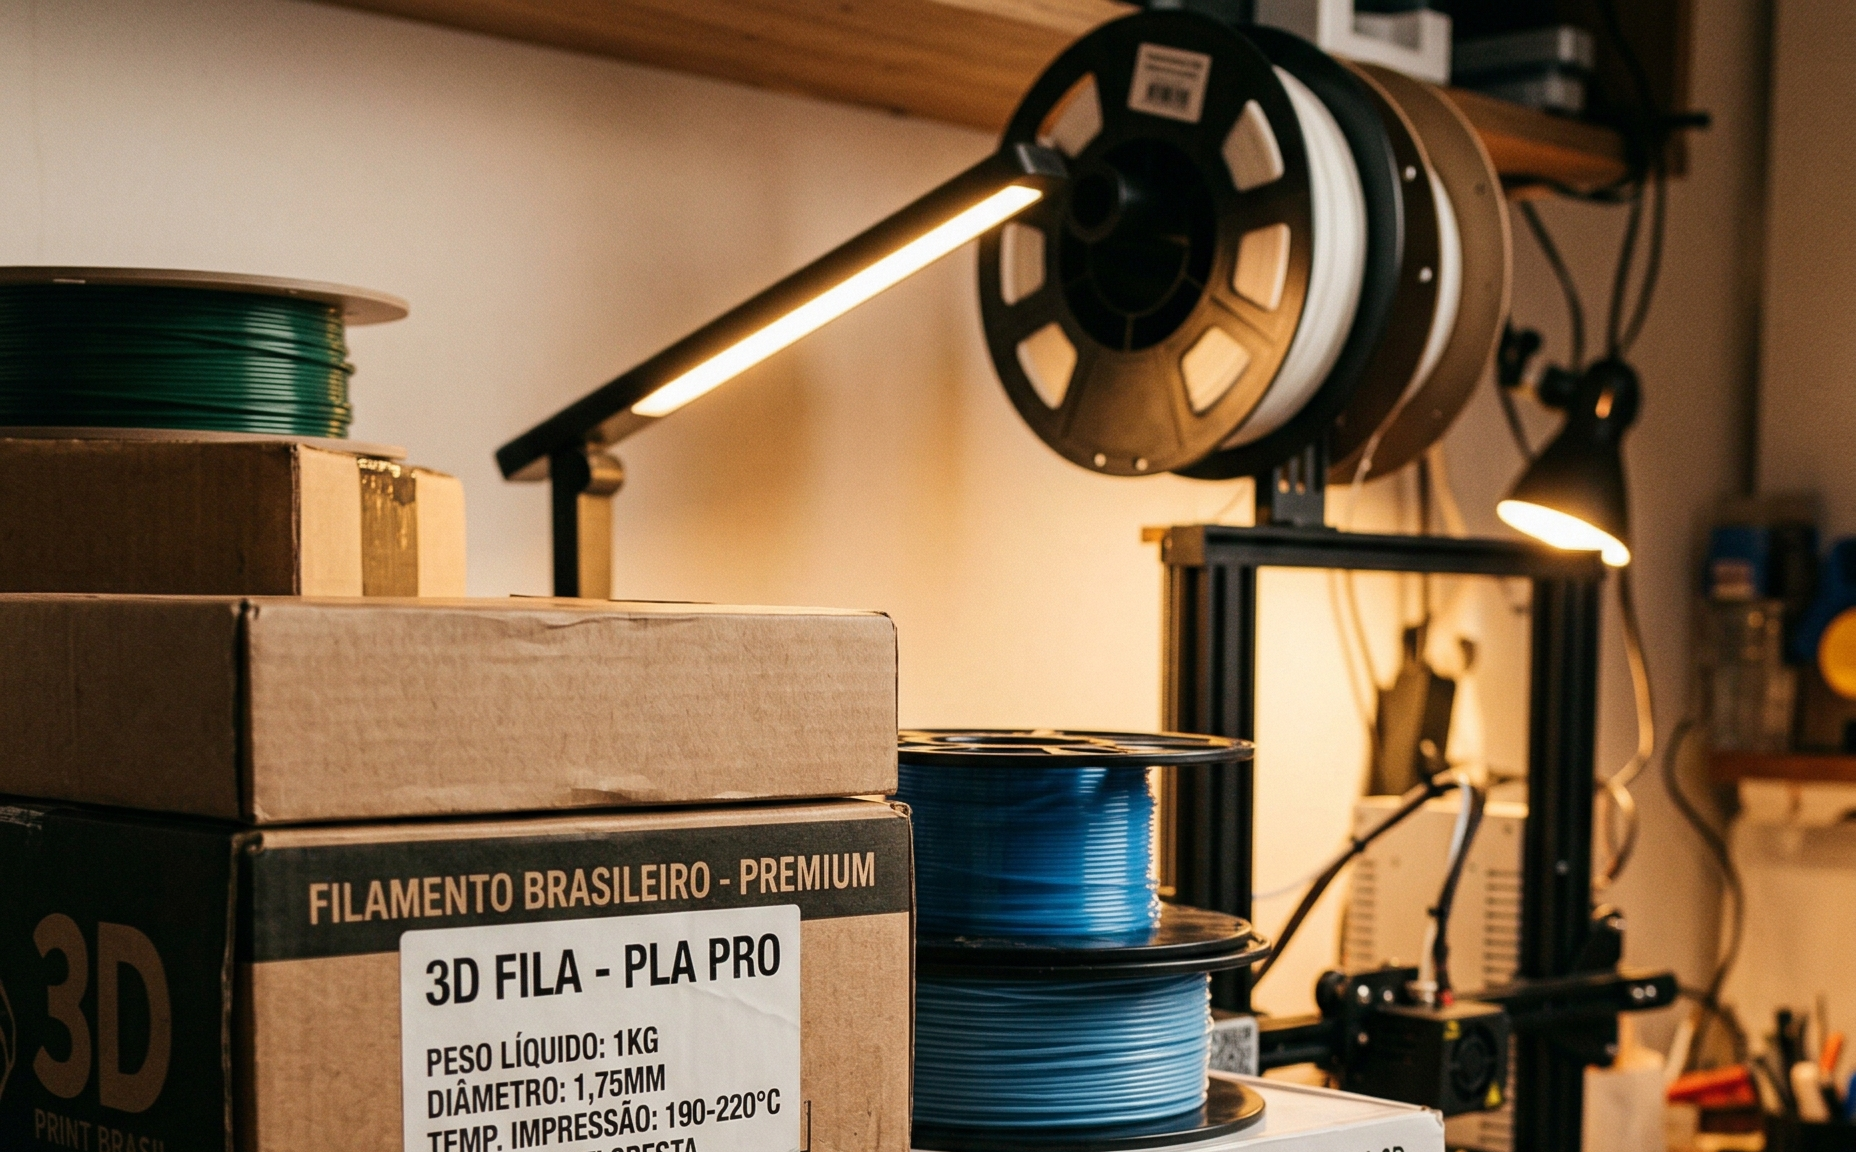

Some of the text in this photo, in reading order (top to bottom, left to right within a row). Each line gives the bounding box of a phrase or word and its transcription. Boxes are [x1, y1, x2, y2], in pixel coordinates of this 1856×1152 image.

[310, 873, 513, 925] FILAMENTO
[524, 861, 710, 909] BRASILEIRO
[741, 852, 875, 894] PREMIUM
[425, 957, 479, 1006] 3D
[496, 949, 582, 1000] FILA
[625, 940, 696, 988] PLA
[709, 933, 781, 981] PRO
[33, 912, 171, 1113] 3D
[427, 1027, 659, 1077] PESO LÍQUIDO: 1KG
[429, 1064, 665, 1119] DIÂMETRO: 1,75MM
[512, 1103, 658, 1149] IMPRESSÃO:
[665, 1088, 781, 1129] 190-220°C
[35, 1108, 90, 1151] PRINT
